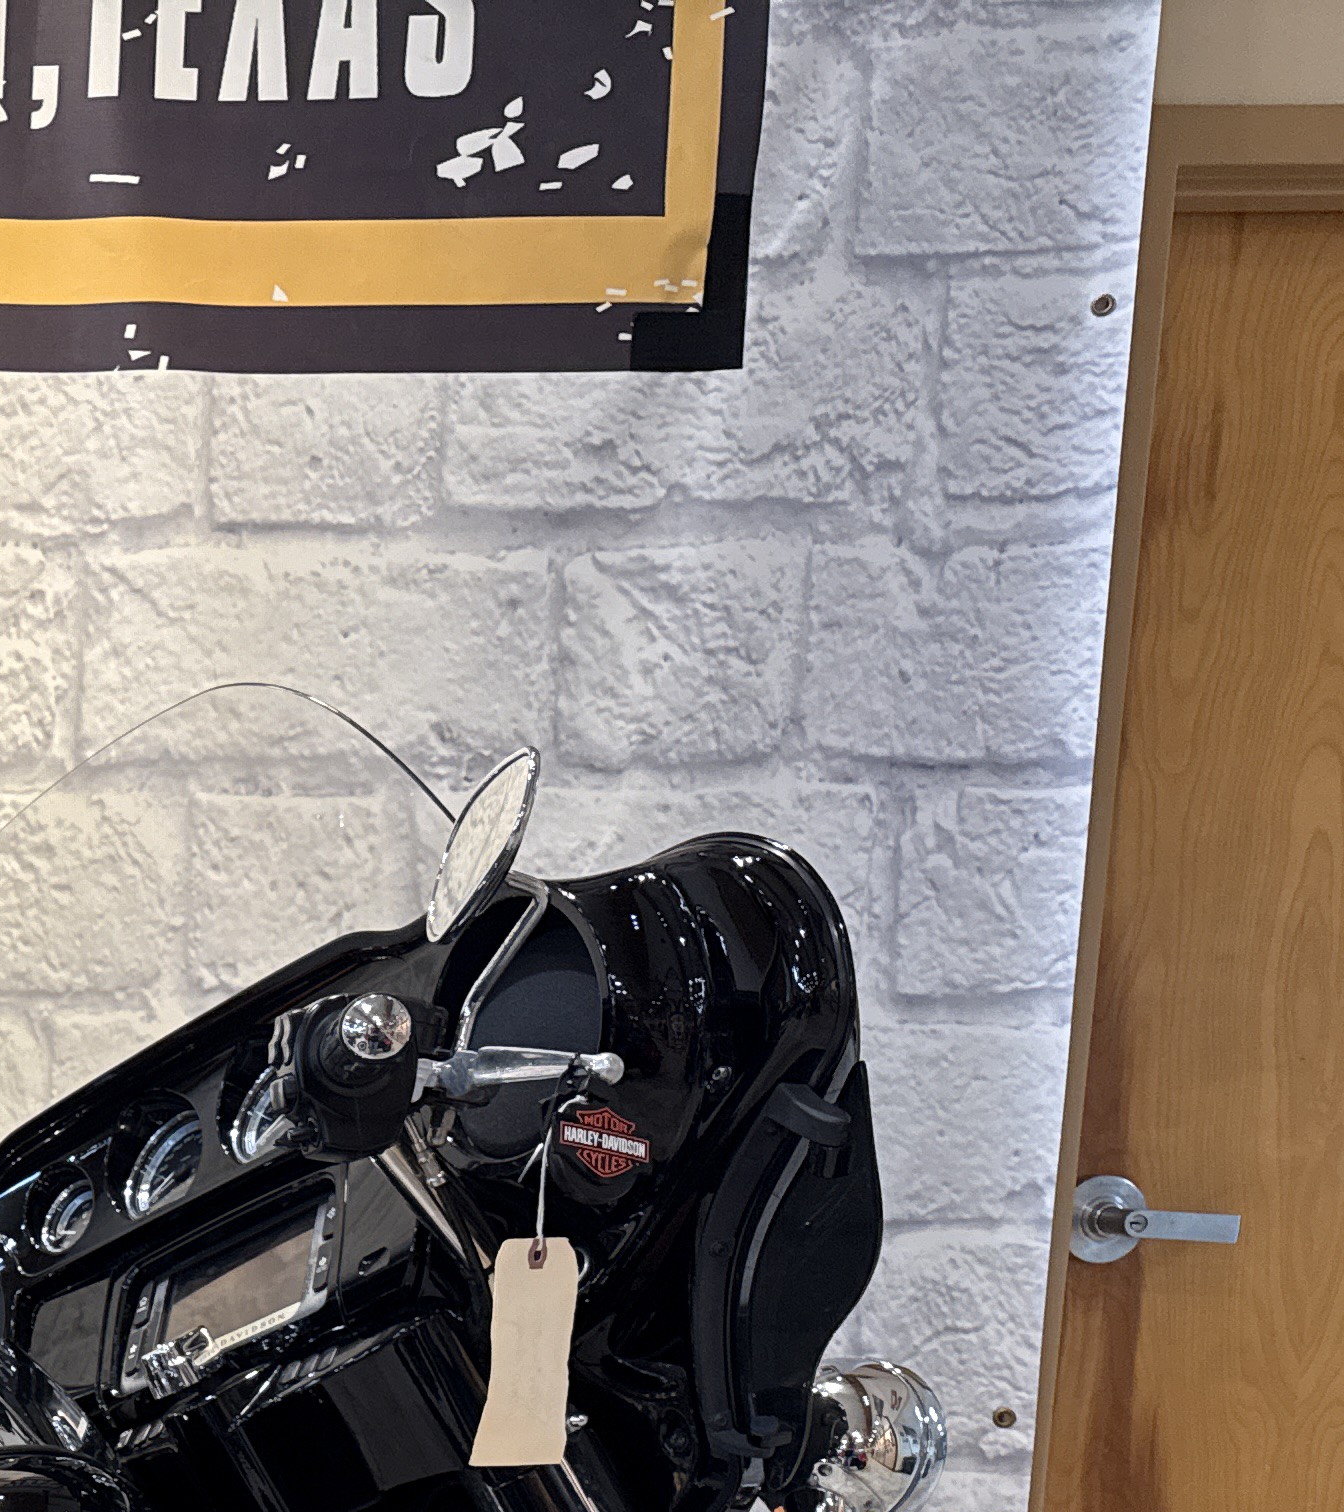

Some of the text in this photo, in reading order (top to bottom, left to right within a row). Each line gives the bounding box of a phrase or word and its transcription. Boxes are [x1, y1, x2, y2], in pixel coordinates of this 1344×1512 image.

[583, 1112, 629, 1134] MOTOR
[563, 1125, 646, 1159] HARLEY-DAVIDSON
[582, 1149, 627, 1173] CYCLES
